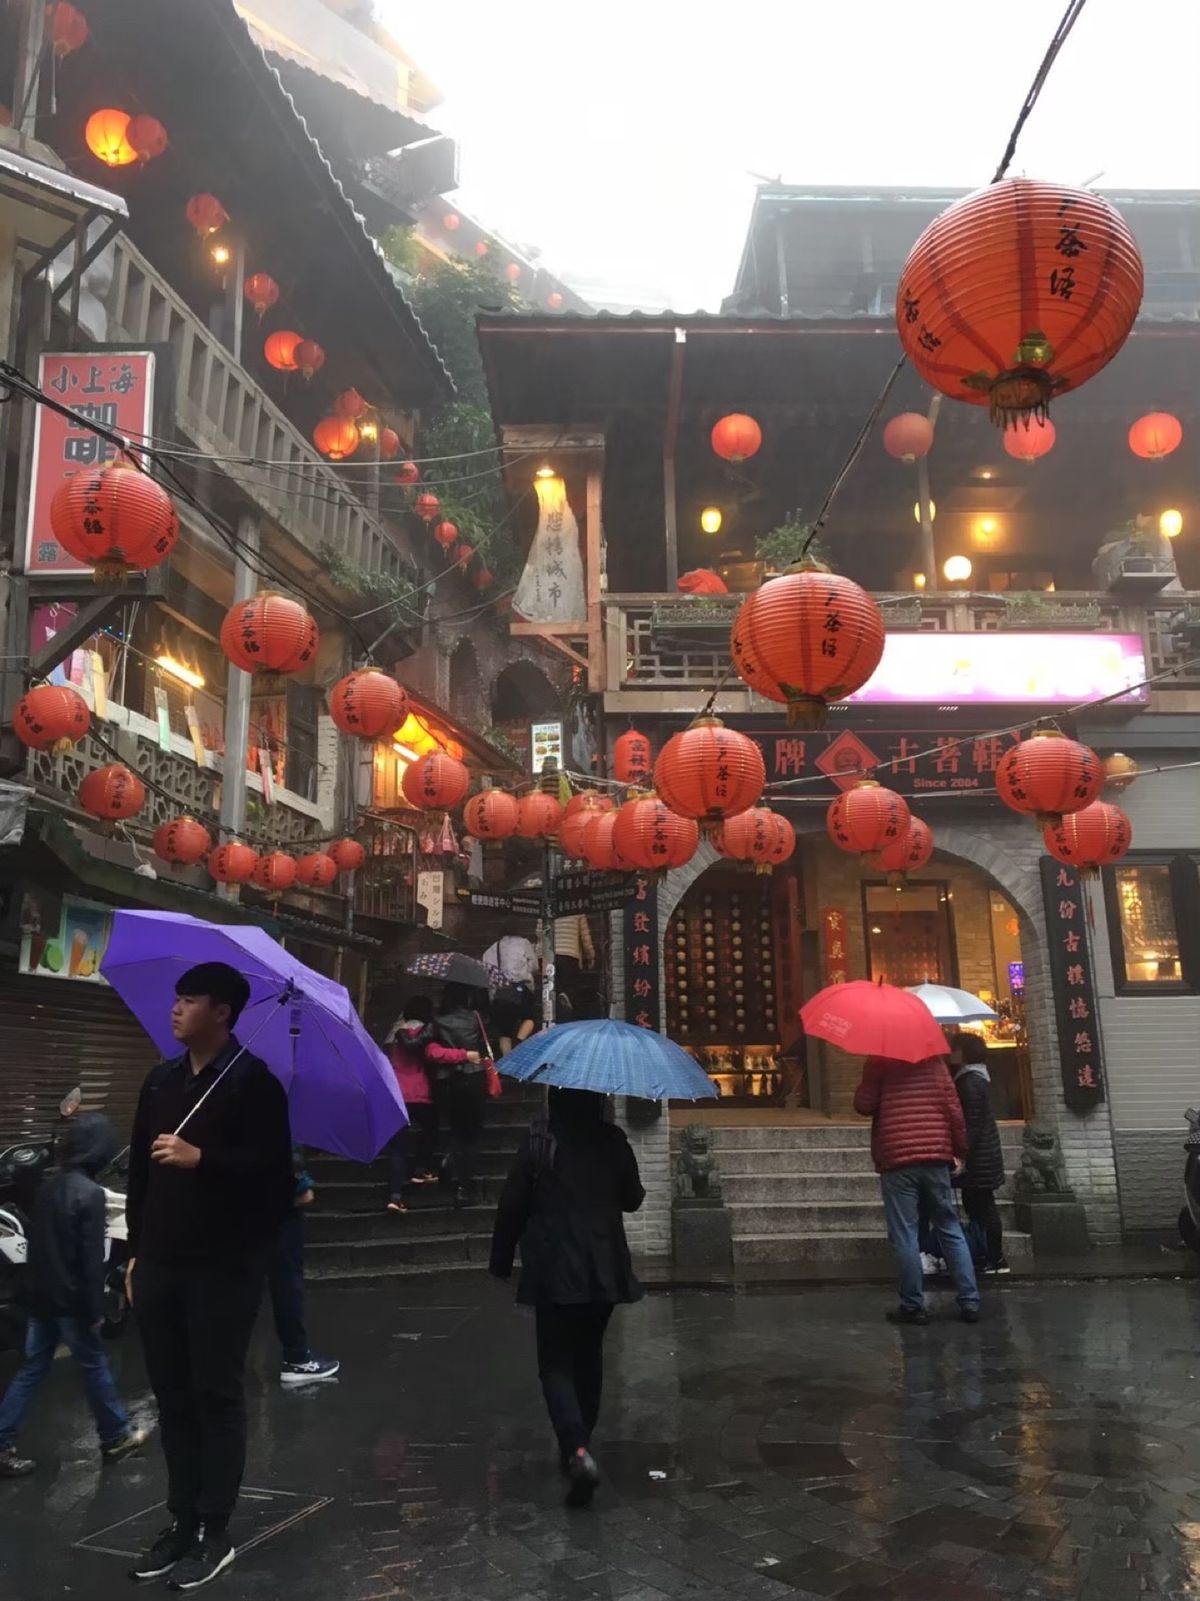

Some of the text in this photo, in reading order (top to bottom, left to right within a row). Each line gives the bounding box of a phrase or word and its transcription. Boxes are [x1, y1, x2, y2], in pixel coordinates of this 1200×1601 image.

[51, 364, 138, 394] 小上海
[545, 511, 567, 608] 悲情城市
[774, 738, 806, 775] 牌
[913, 777, 979, 788] Since 2004
